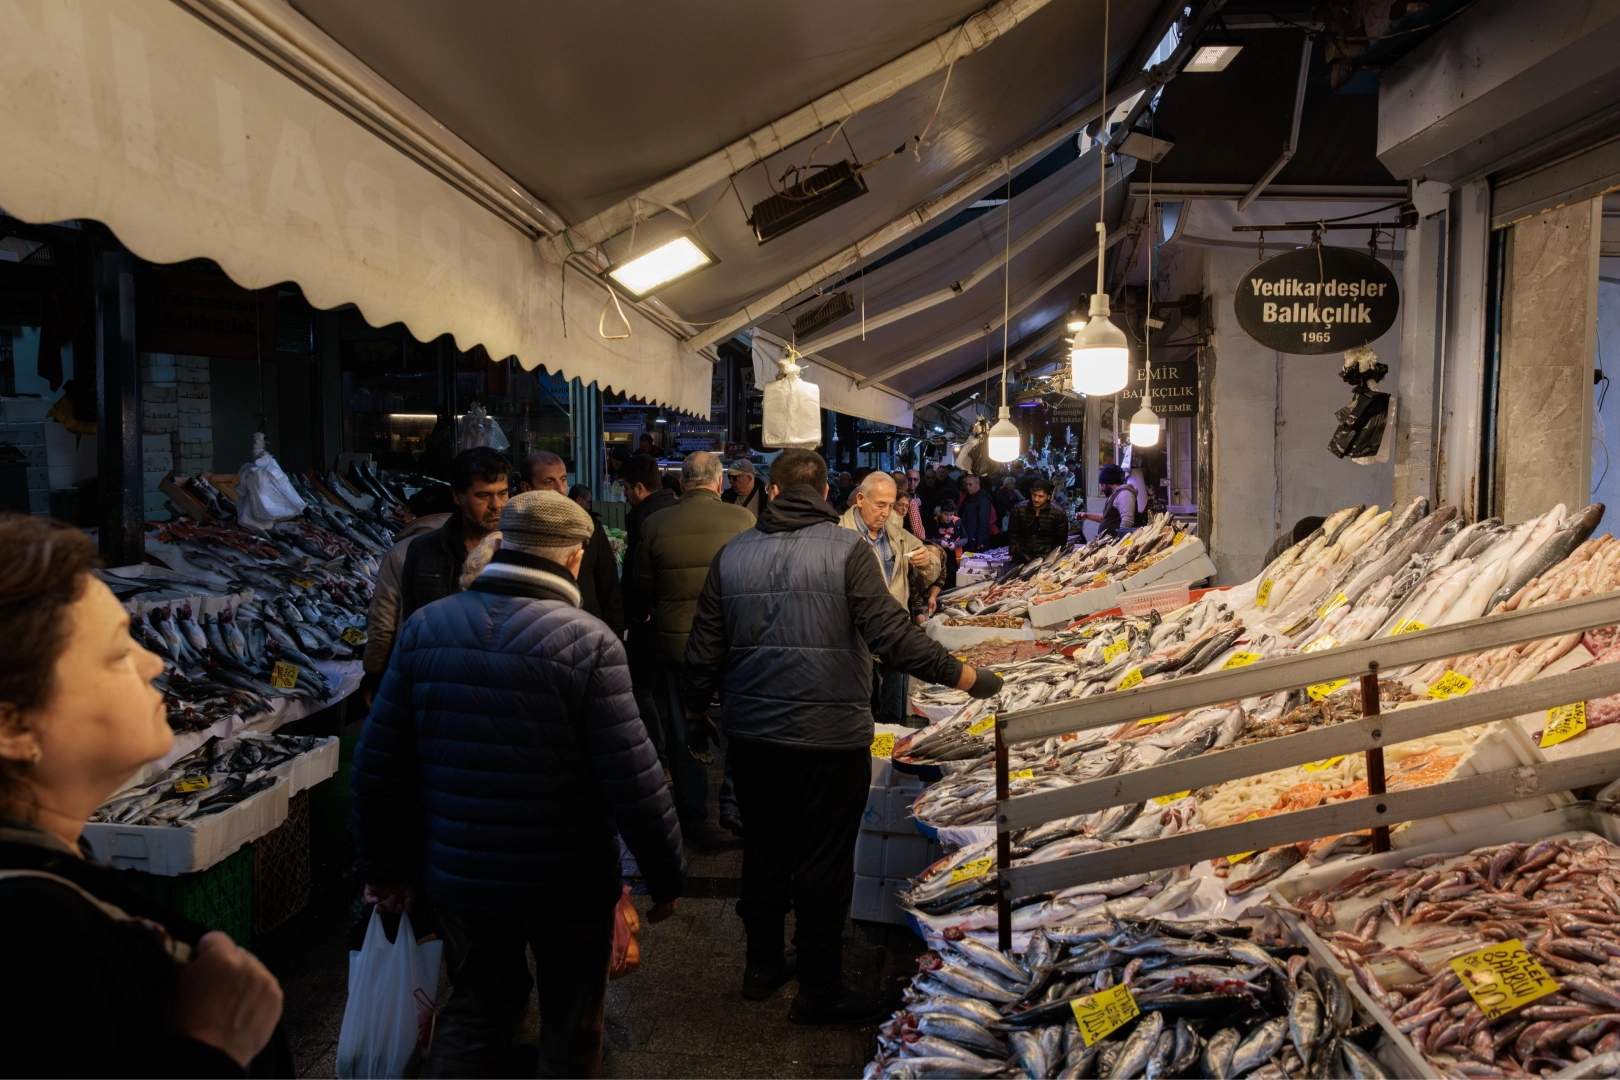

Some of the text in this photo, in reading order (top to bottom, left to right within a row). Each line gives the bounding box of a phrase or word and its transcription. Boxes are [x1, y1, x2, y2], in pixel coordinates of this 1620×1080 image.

[1251, 278, 1387, 303] Yedikardeşler
[1262, 302, 1372, 329] Balıkçılık
[1301, 332, 1331, 343] 1965
[1136, 365, 1179, 381] EMİR
[1168, 403, 1192, 412] EMİR
[1483, 950, 1538, 998] BARBUN
